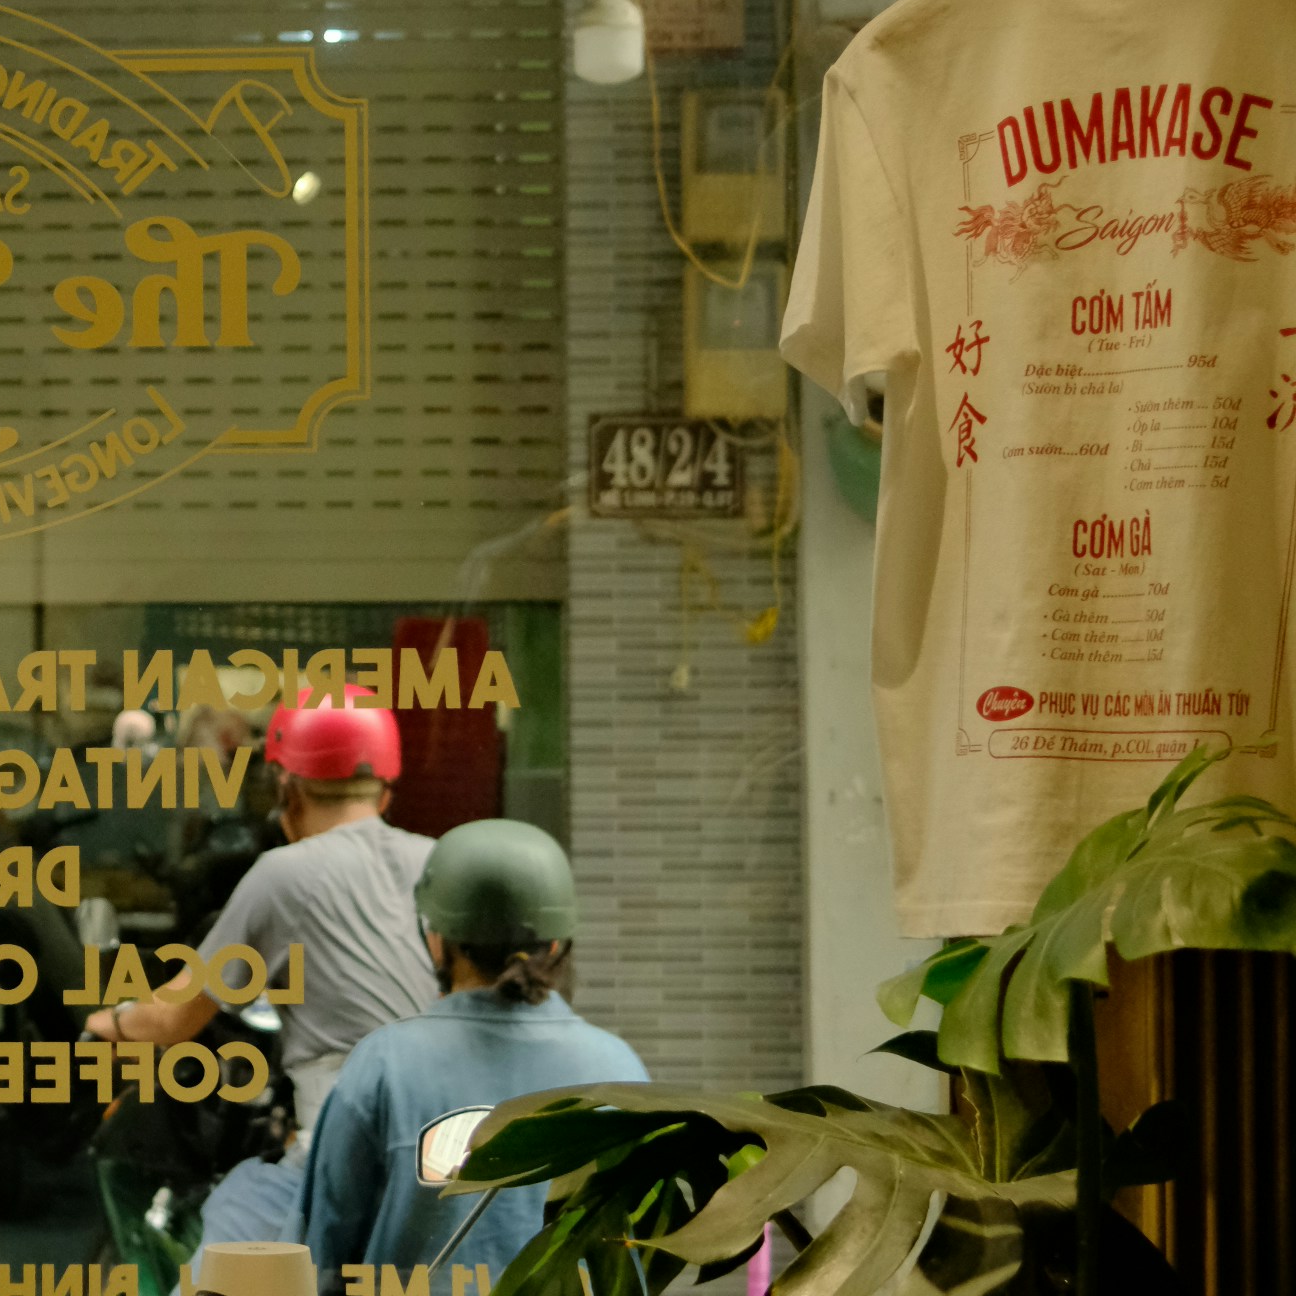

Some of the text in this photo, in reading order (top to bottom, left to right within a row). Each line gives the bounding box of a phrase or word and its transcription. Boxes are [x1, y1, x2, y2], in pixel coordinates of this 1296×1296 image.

[997, 83, 1273, 188] DUMAKASE
[1055, 204, 1176, 256] Saigon
[1071, 278, 1172, 336] CƠM TẤM
[945, 319, 990, 468] 好食
[1072, 509, 1152, 559] CƠM GÀ
[1039, 691, 1076, 718] PHỤC
[1081, 693, 1099, 720] VỤ
[1104, 689, 1131, 717] CÁC
[1227, 689, 1250, 717] TÚY
[1010, 735, 1029, 750] 26
